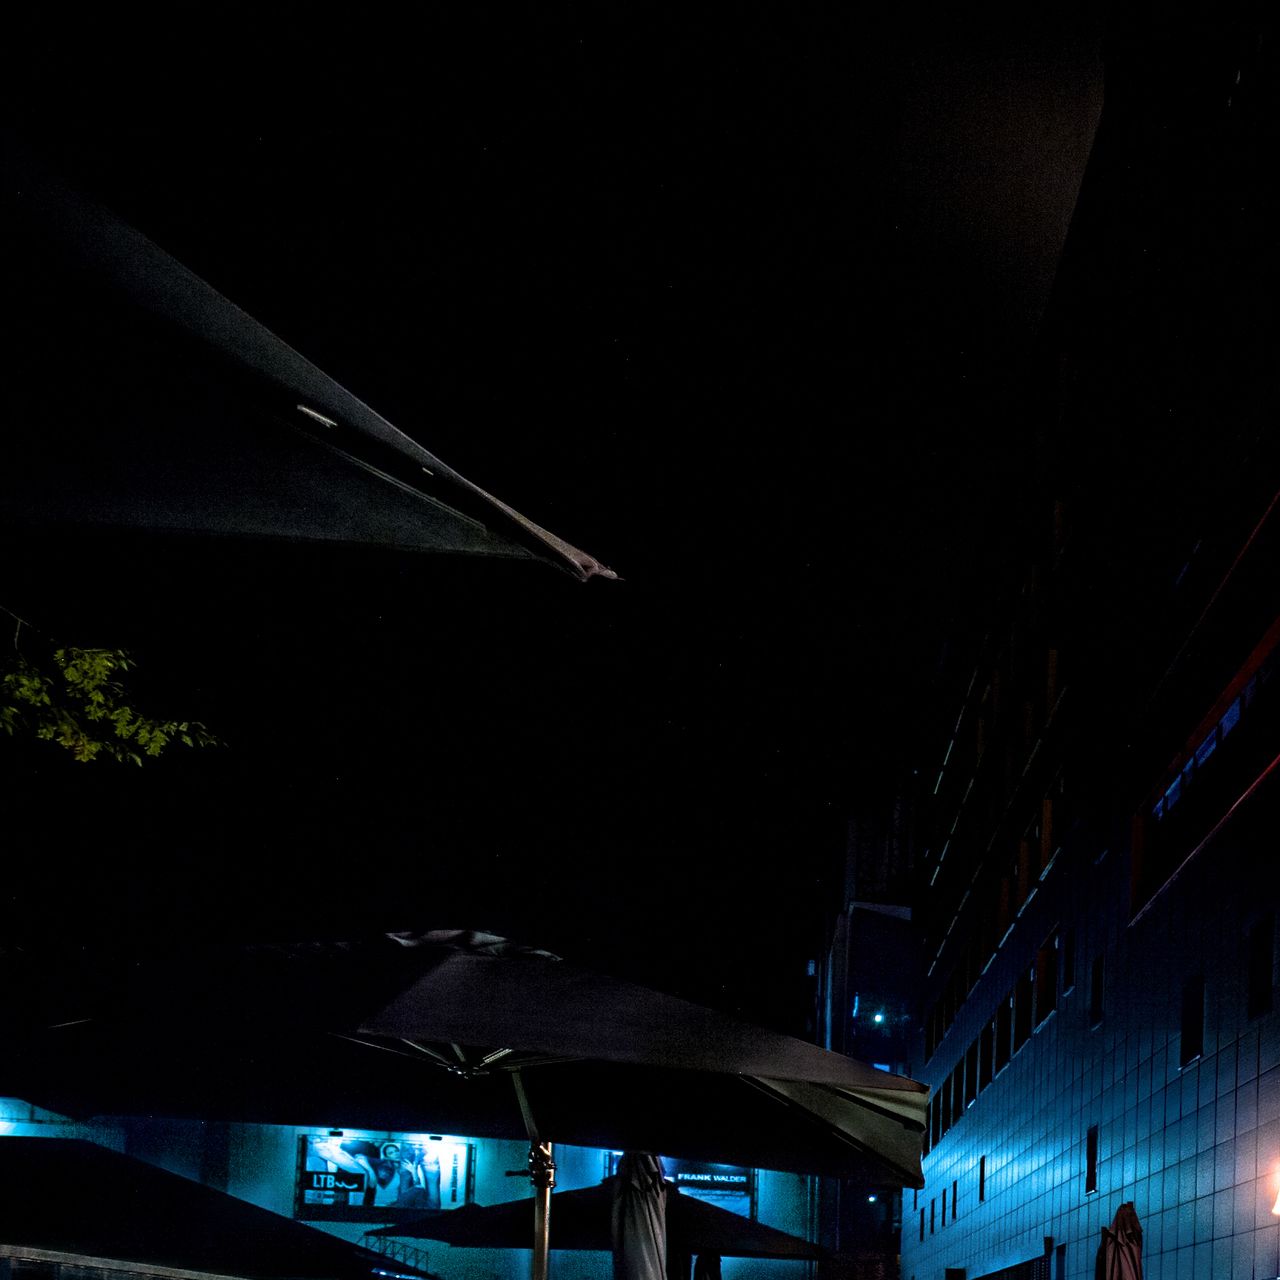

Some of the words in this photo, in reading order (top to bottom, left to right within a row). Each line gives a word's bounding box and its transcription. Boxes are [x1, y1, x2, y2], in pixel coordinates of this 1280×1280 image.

[313, 1174, 335, 1188] LTB
[677, 1173, 711, 1181] FRANK
[713, 1175, 747, 1183] WALDER
